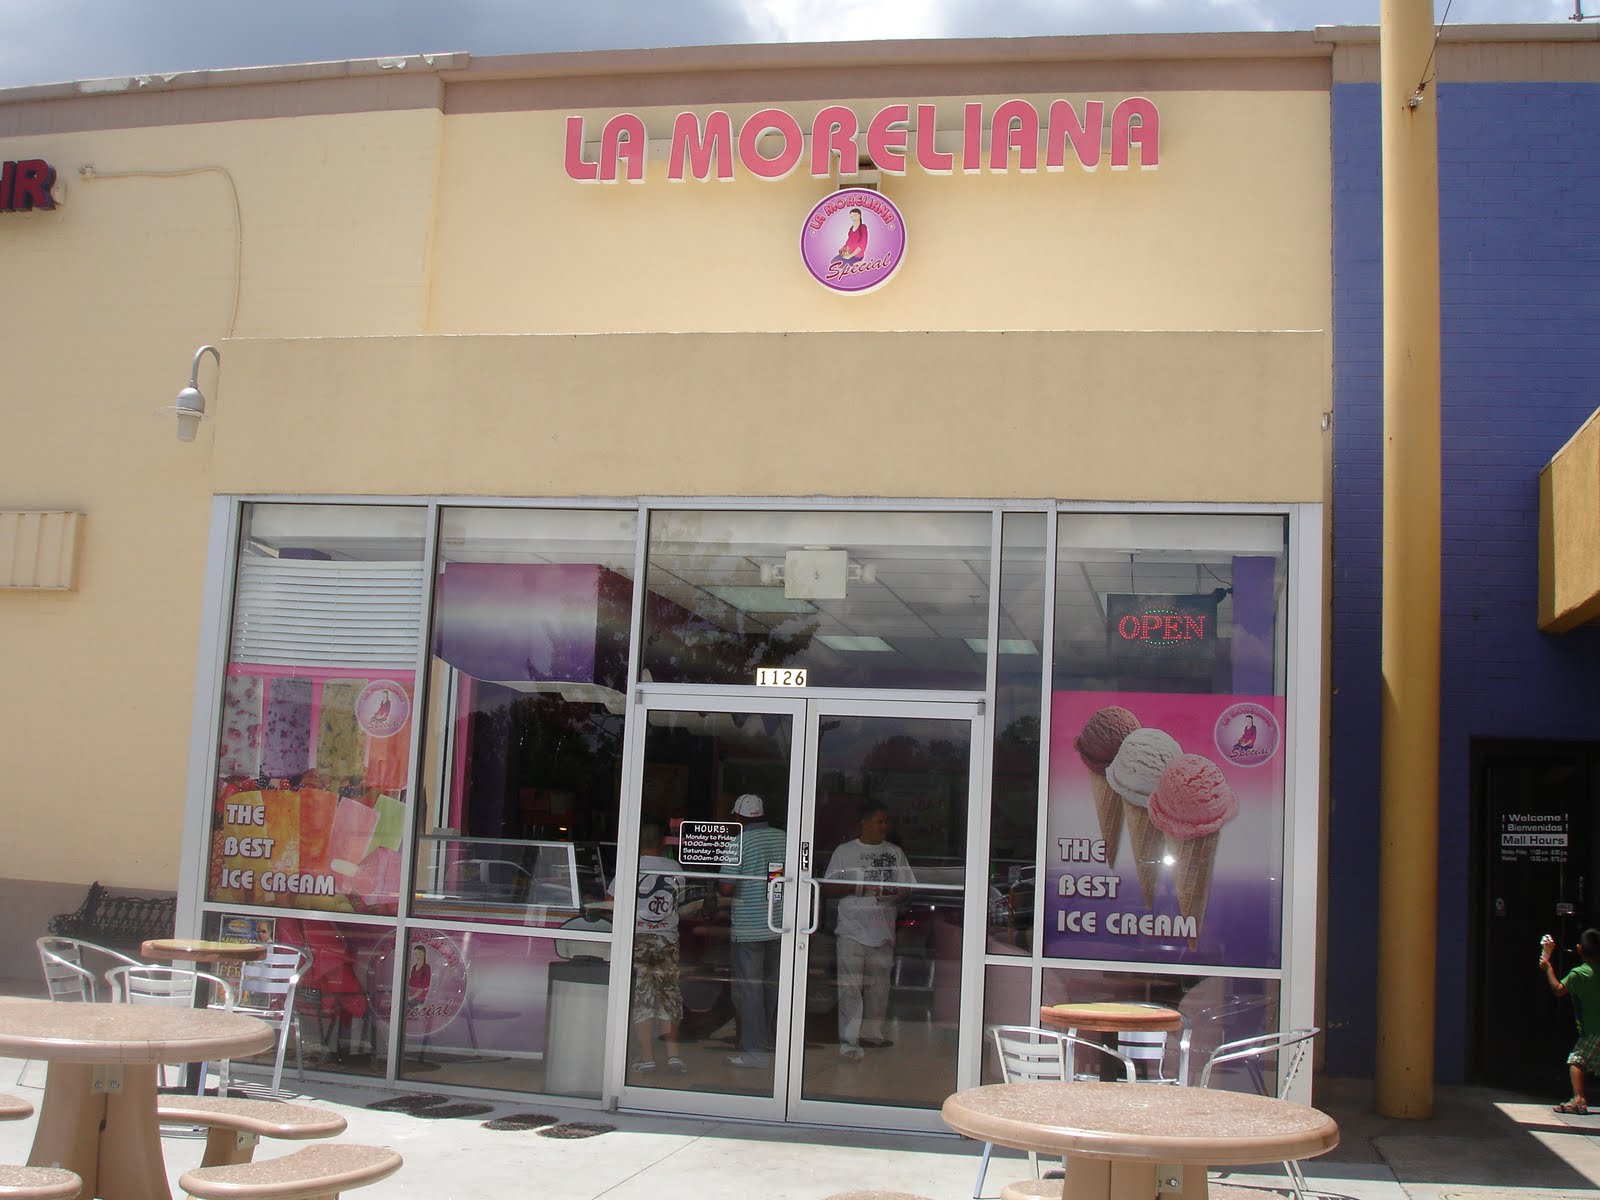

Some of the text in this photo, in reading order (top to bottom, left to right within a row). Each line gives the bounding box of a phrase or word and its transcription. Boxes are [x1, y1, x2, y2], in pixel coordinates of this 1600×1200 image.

[564, 96, 1160, 184] LA MORELIANA
[809, 195, 895, 230] LA MORELIANA
[825, 251, 892, 280] Special
[1118, 615, 1207, 640] OPEN
[760, 670, 804, 686] 1126
[226, 804, 266, 826] THE
[1508, 814, 1562, 822] Welcome
[694, 824, 729, 834] HOURS:
[1507, 823, 1563, 832] Bienvenidos
[224, 836, 275, 859] BEST
[683, 847, 712, 855] Saturday
[715, 848, 739, 856] Sunday
[1058, 838, 1107, 862] THE
[1503, 835, 1565, 845] Mall Hours
[221, 868, 336, 896] ICE CREAM
[1058, 874, 1121, 898] BEST
[1057, 910, 1197, 938] ICE CREAM
